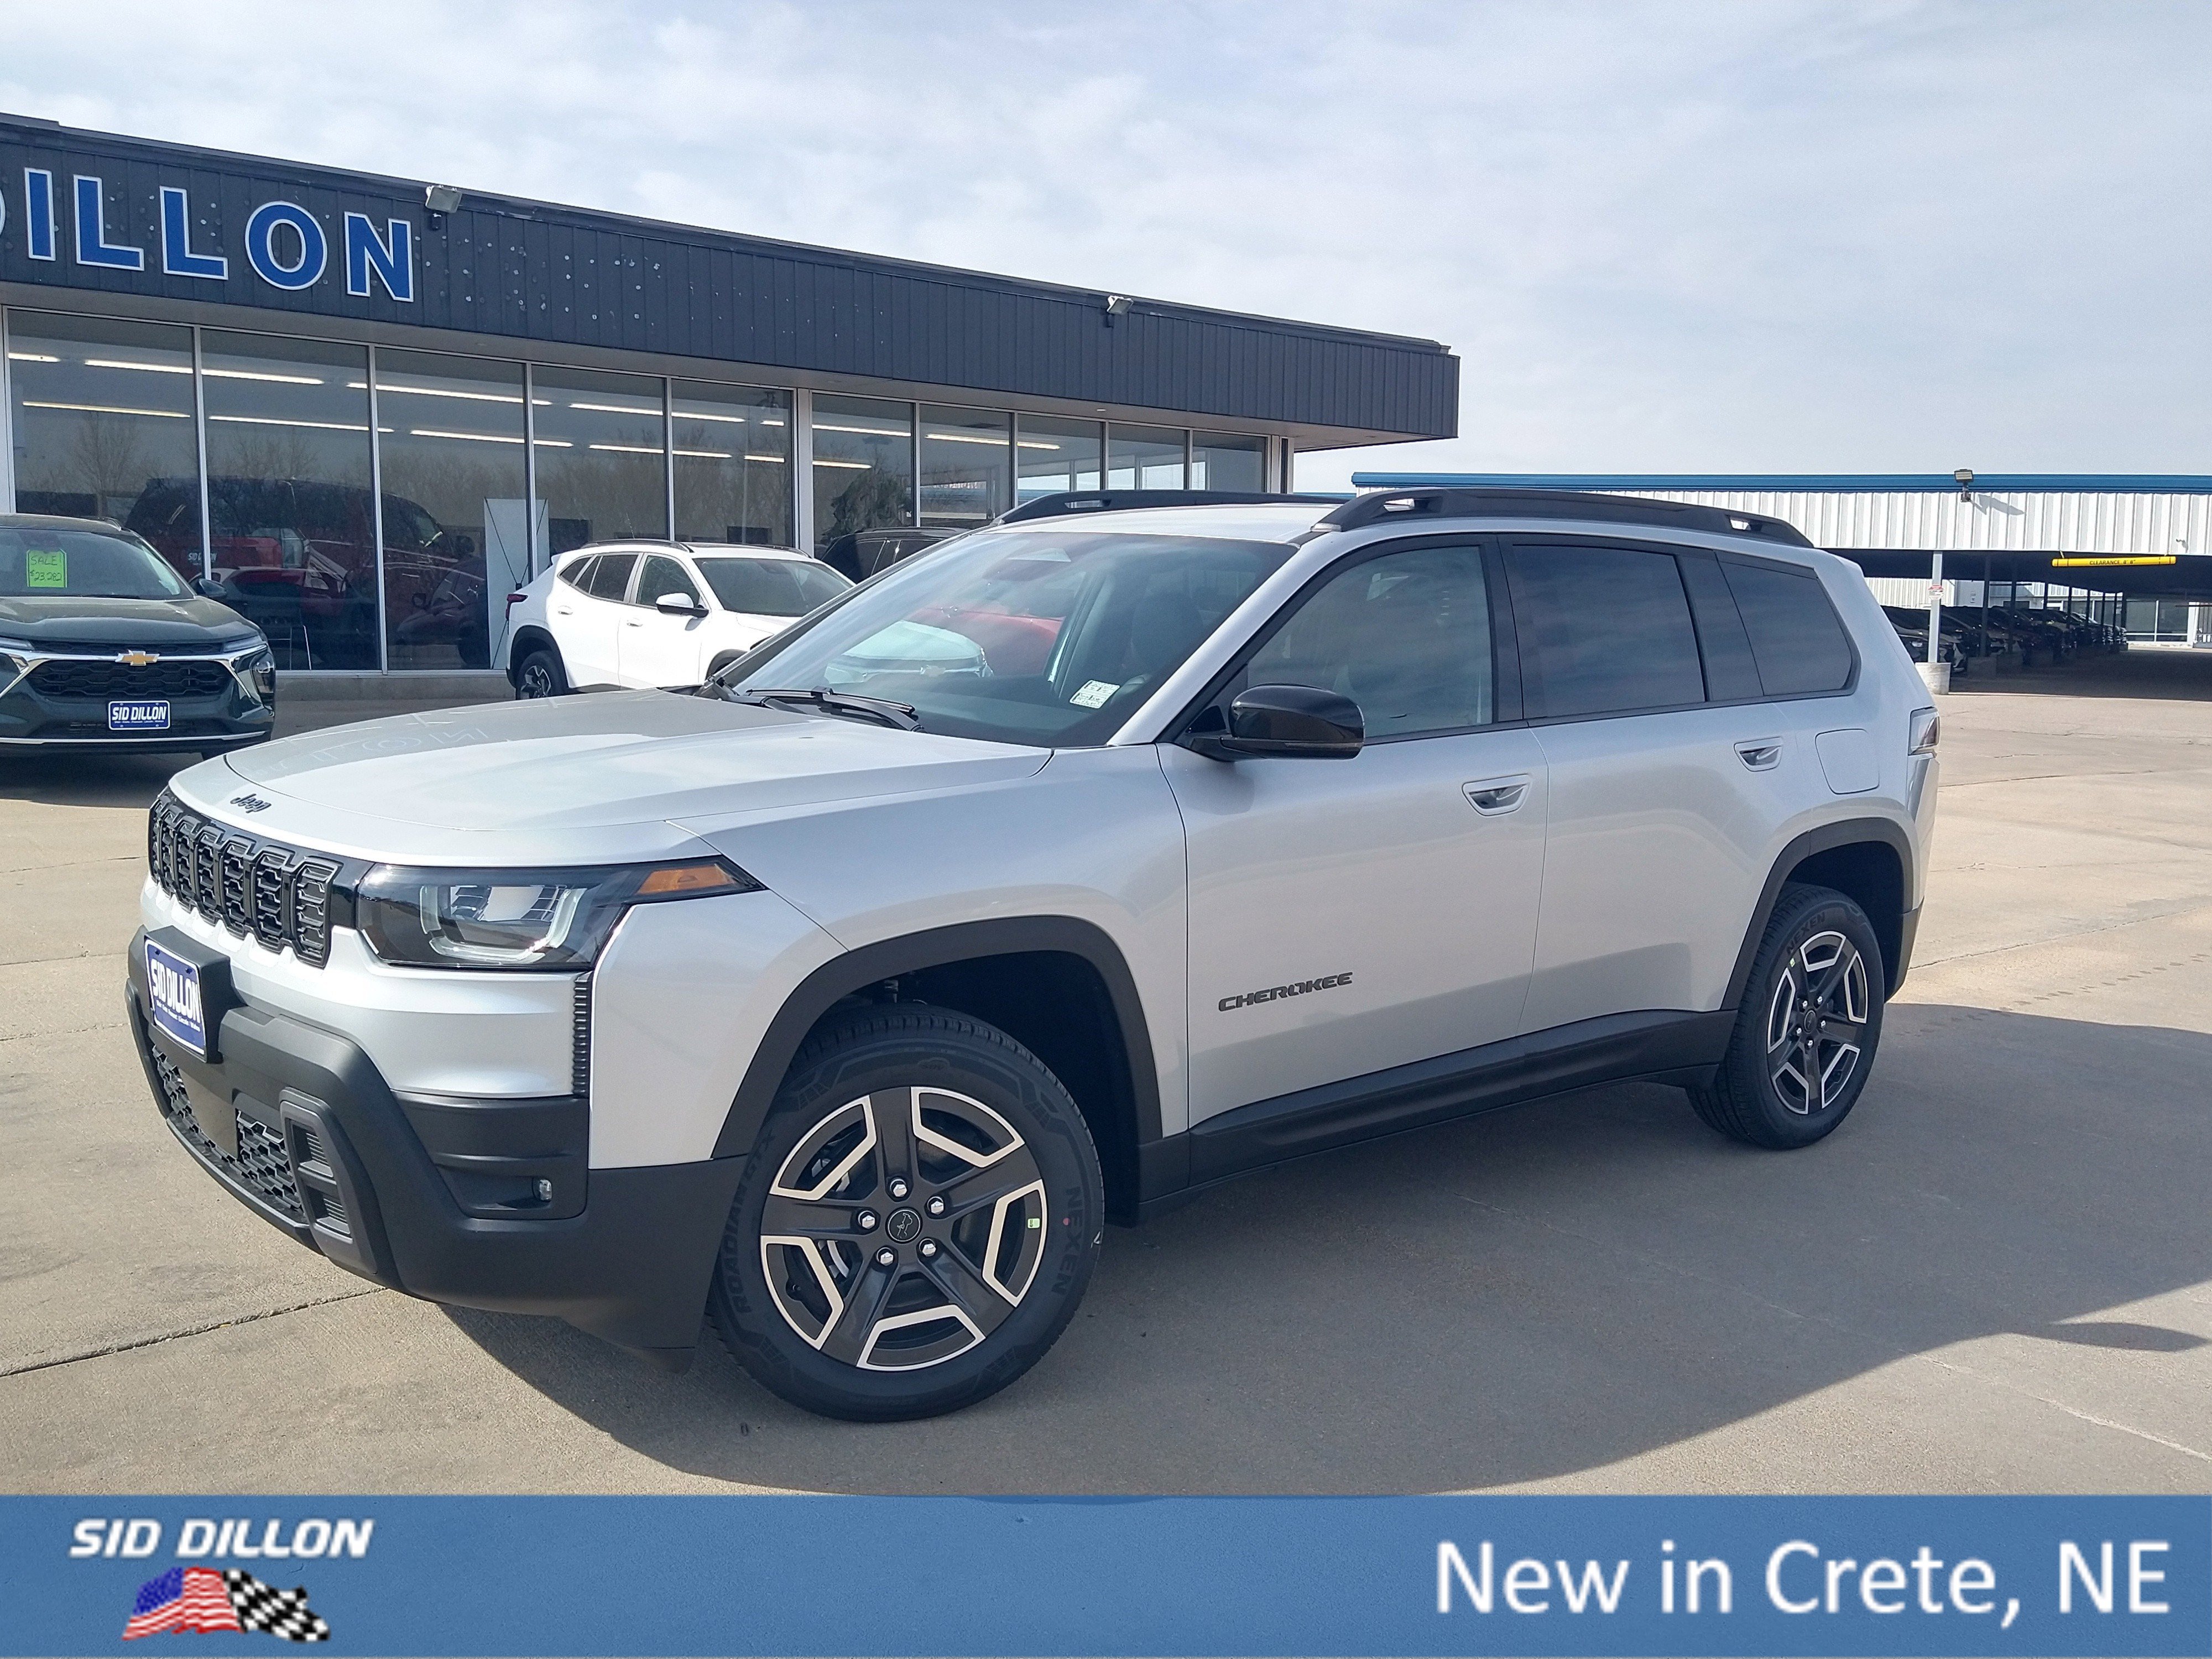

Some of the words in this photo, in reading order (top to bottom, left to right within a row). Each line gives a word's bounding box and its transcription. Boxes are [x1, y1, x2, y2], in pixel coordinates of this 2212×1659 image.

[0, 168, 413, 302] ILLON
[112, 707, 130, 721] SID
[131, 706, 167, 720] DILLON
[230, 793, 272, 813] Jeep
[1786, 911, 1825, 956] NEXEN
[151, 958, 166, 1002] SID
[166, 967, 201, 1023] DILLON
[1218, 972, 1353, 1011] CHEROKEE
[723, 1183, 753, 1314] ROADIAN
[1051, 1187, 1083, 1296] NEXEN
